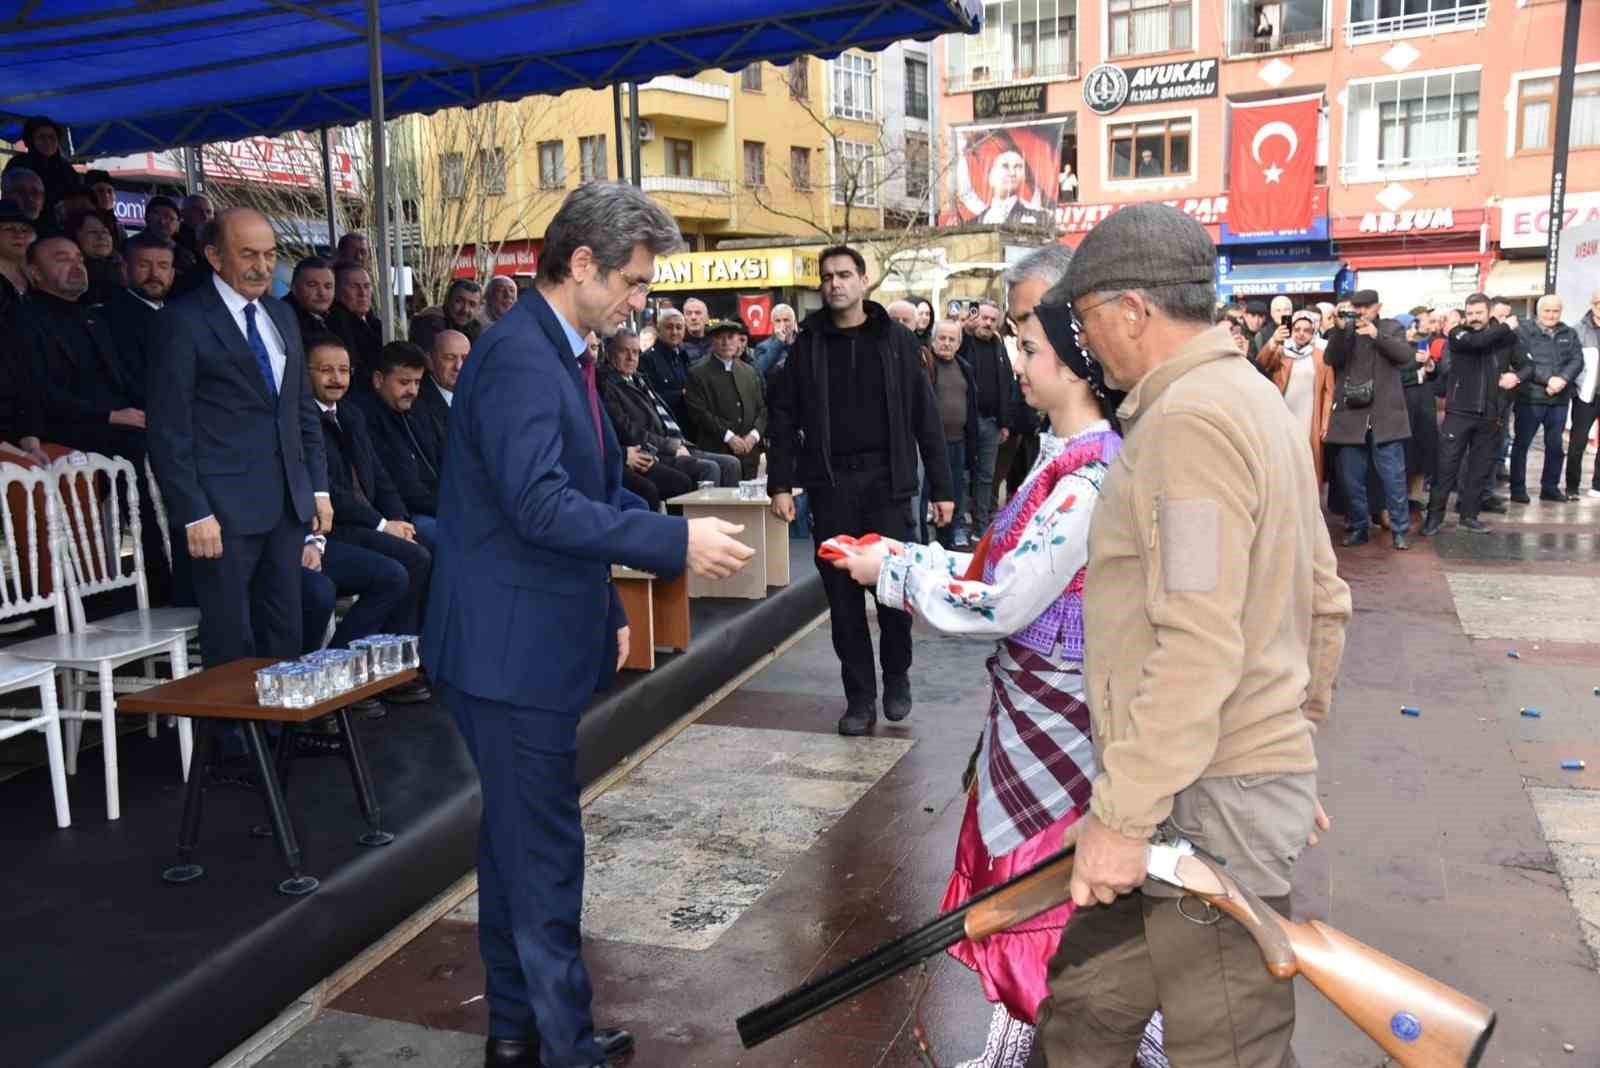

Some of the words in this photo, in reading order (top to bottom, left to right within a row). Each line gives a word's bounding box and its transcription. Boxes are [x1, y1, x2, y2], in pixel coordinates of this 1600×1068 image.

[1130, 60, 1215, 88] AVUKAT
[996, 86, 1043, 105] AVUKAT
[1129, 87, 1159, 102] İLYAS
[1160, 82, 1216, 100] SARIOĞLU
[1359, 207, 1455, 233] ARZUM
[702, 257, 769, 282] TAKSİ
[1232, 283, 1278, 296] KONAK
[1285, 280, 1321, 293] BÜFE
